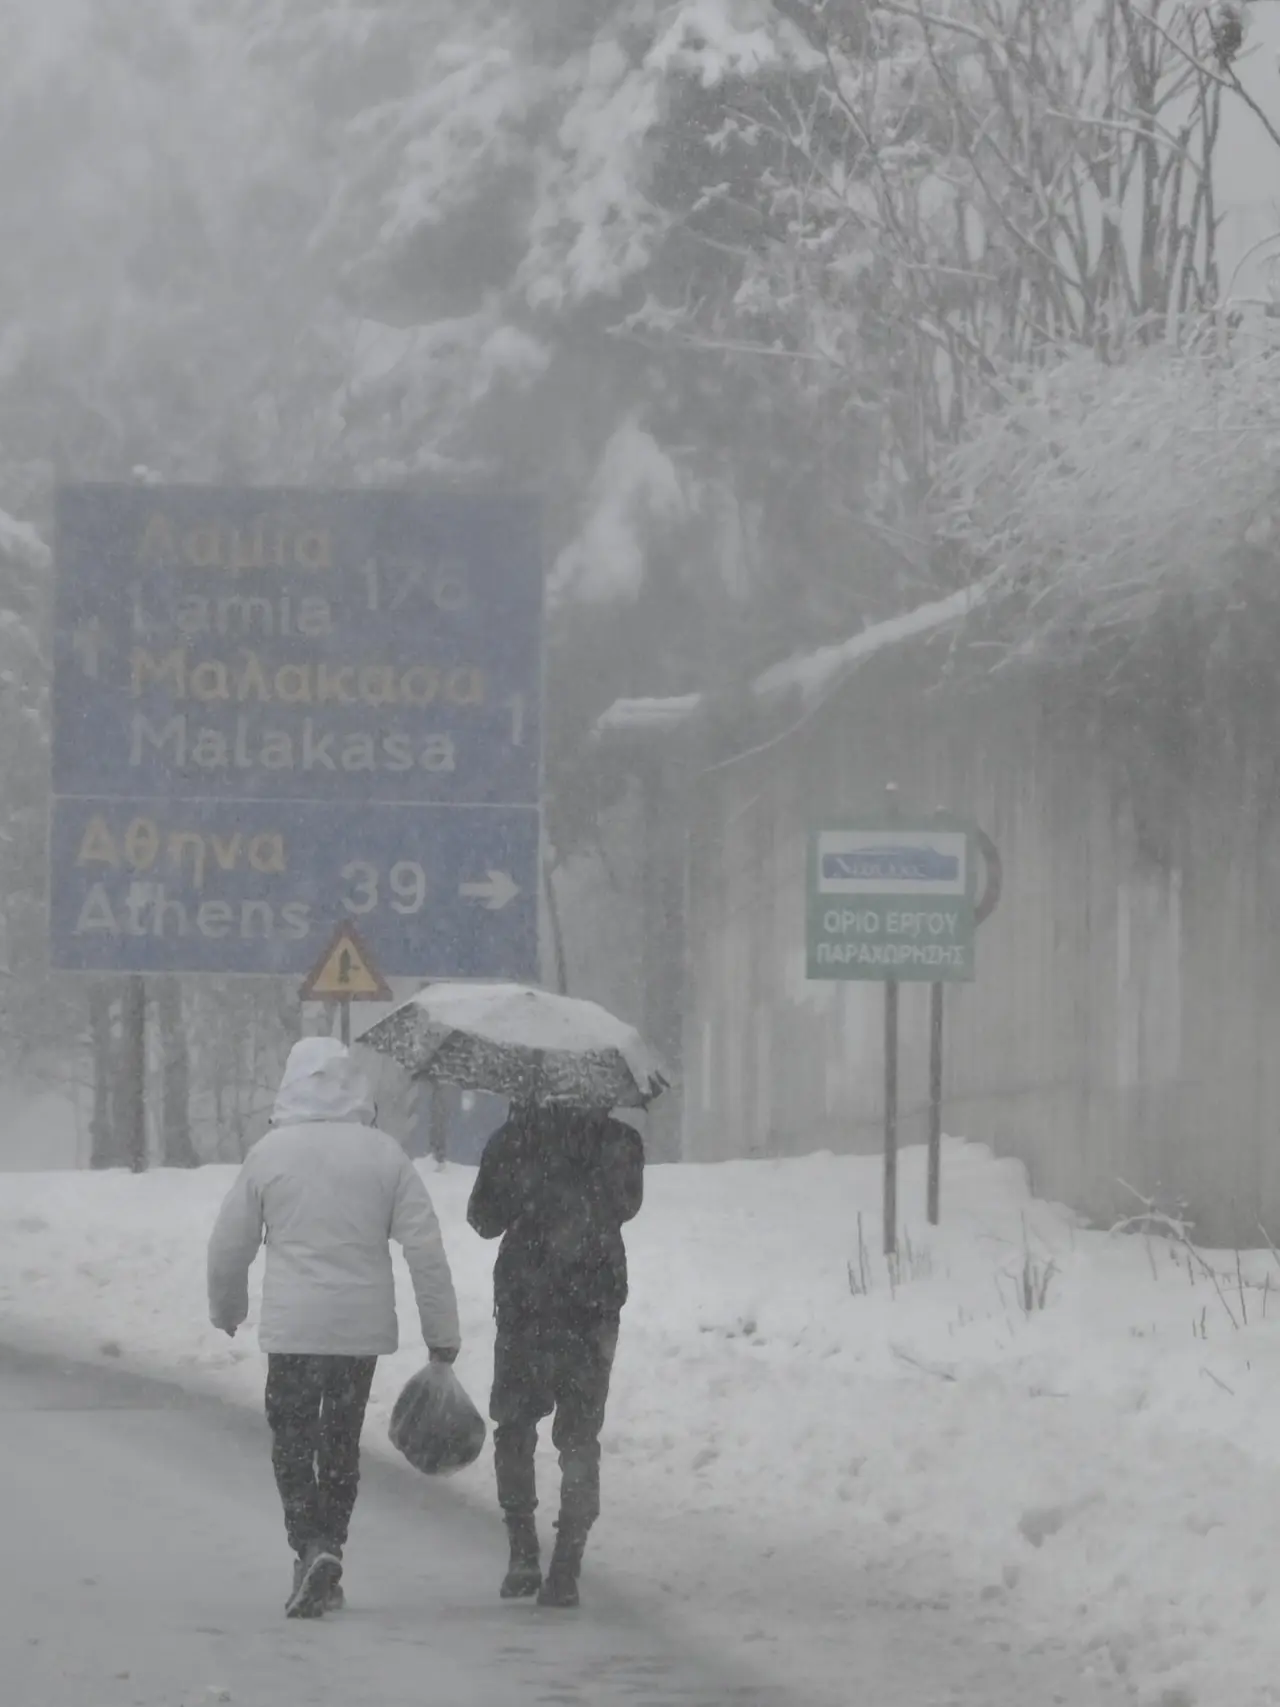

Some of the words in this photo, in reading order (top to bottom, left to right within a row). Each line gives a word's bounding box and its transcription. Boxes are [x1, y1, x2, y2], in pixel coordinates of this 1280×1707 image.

[132, 580, 332, 637] Lamia
[129, 713, 456, 771] Malakasa
[509, 693, 524, 746] 1
[74, 882, 312, 939] Athens
[340, 860, 427, 914] 39
